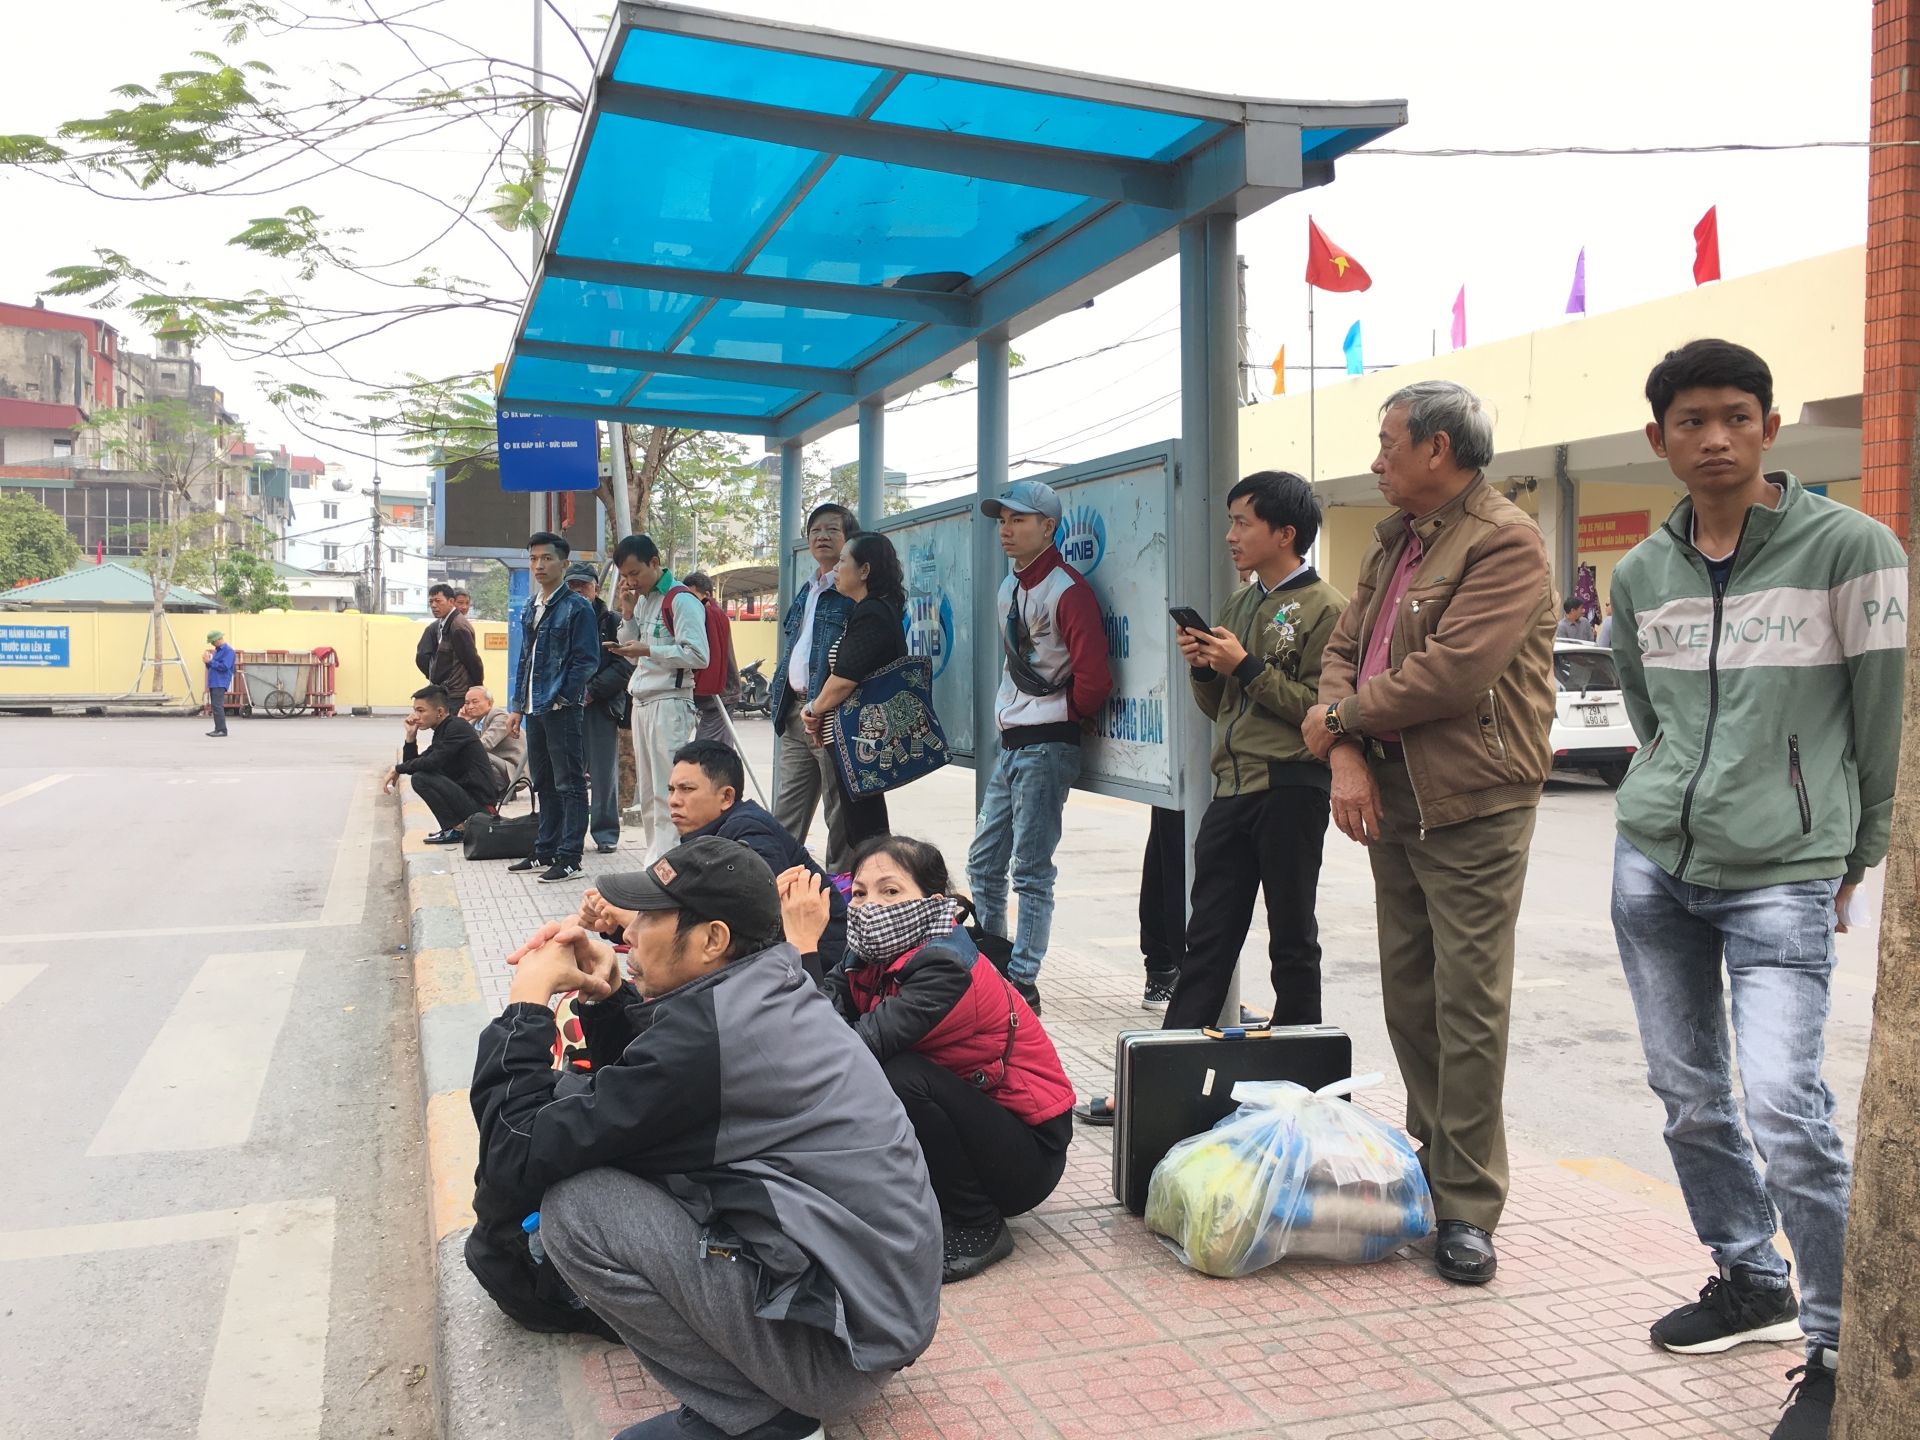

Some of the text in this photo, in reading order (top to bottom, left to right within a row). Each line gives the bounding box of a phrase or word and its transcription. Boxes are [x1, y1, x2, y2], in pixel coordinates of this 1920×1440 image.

[1065, 540, 1094, 563] HNB
[1862, 596, 1906, 628] PA
[8, 627, 25, 639] HÀNH
[25, 628, 45, 639] KHÁCH
[45, 630, 59, 639] MUA
[911, 630, 941, 656] HNB
[1, 640, 51, 652] TRƯỚC KHI LÊN XE
[1109, 688, 1137, 742] CÔNG
[1140, 690, 1163, 744] DÂN
